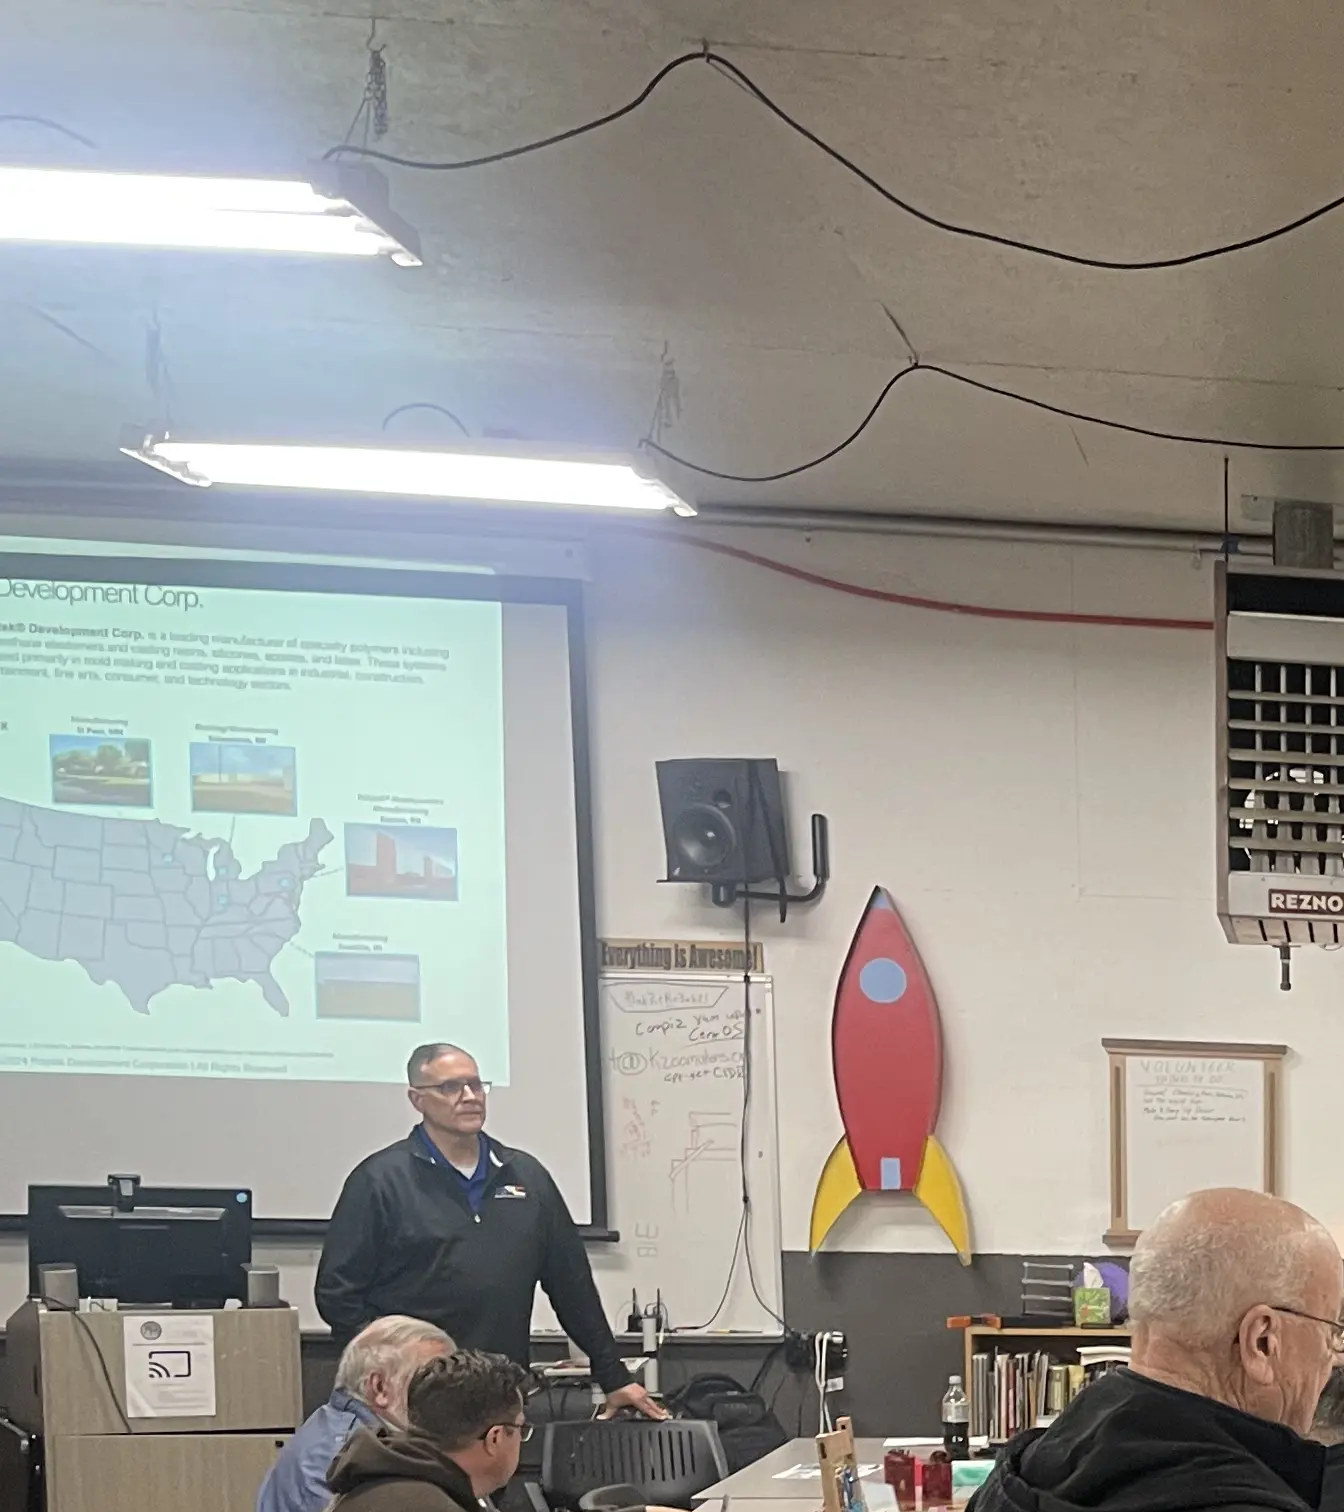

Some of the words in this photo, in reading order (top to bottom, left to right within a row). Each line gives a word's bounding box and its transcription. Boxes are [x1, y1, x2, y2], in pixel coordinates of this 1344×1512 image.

[0, 577, 138, 606] Development
[144, 585, 204, 611] Corp.
[601, 942, 671, 970] Everything
